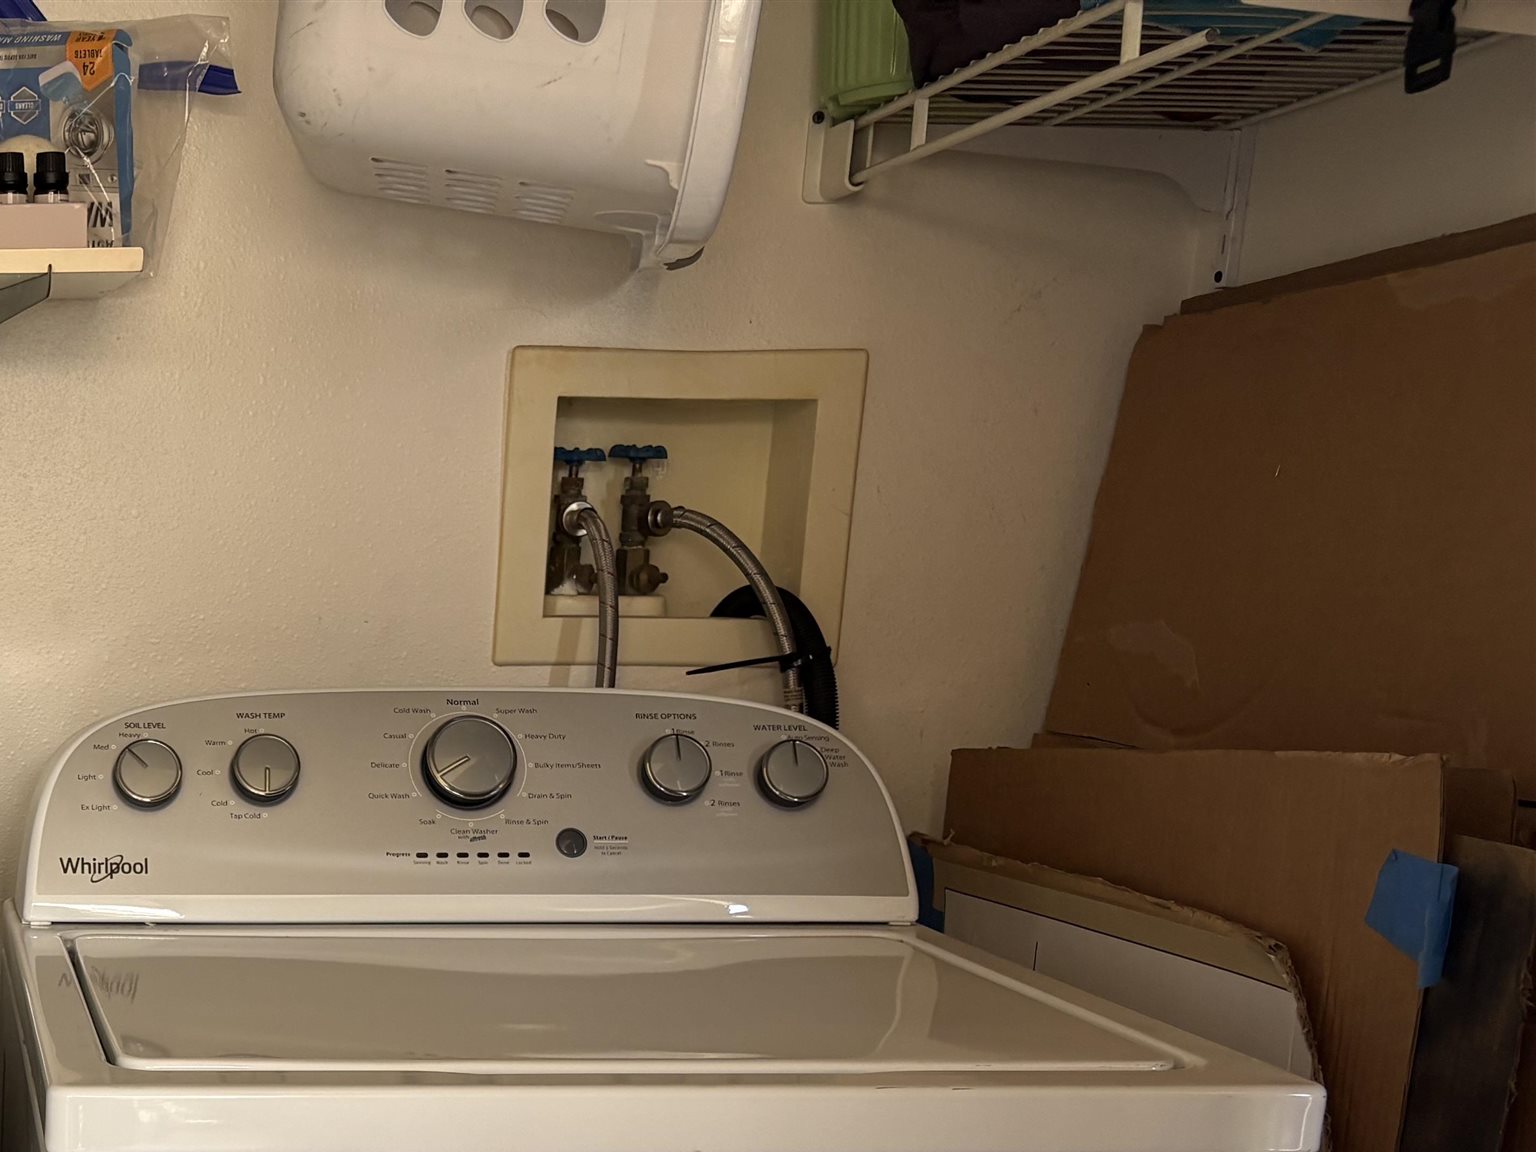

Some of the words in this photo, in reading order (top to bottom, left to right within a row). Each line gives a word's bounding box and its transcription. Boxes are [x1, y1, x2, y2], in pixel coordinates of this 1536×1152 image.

[82, 62, 96, 76] 24
[446, 698, 479, 706] Normal
[549, 733, 566, 741] Duty
[77, 774, 96, 782] Light
[59, 855, 149, 884] Whirlpool
